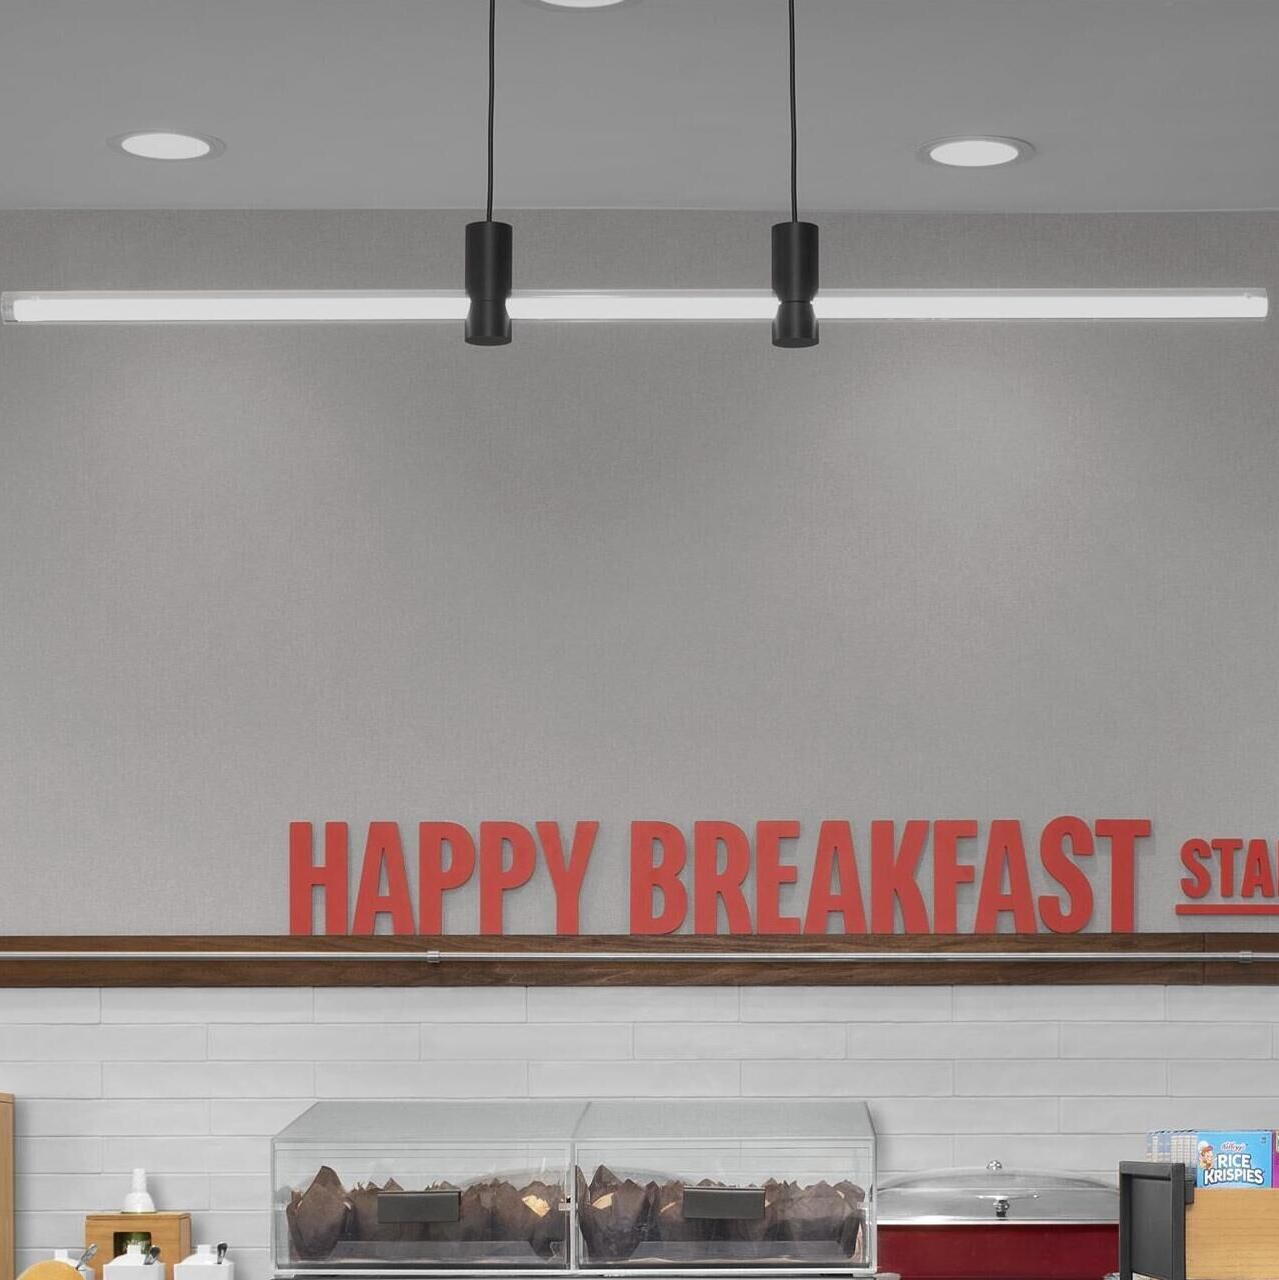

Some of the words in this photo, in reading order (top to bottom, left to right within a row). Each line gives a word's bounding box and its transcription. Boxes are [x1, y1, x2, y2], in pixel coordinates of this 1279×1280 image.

[289, 821, 597, 934] HAPPY
[630, 816, 1150, 934] BREAKFAST
[1217, 1154, 1251, 1168] RICE
[1204, 1168, 1264, 1185] KRISPIES
